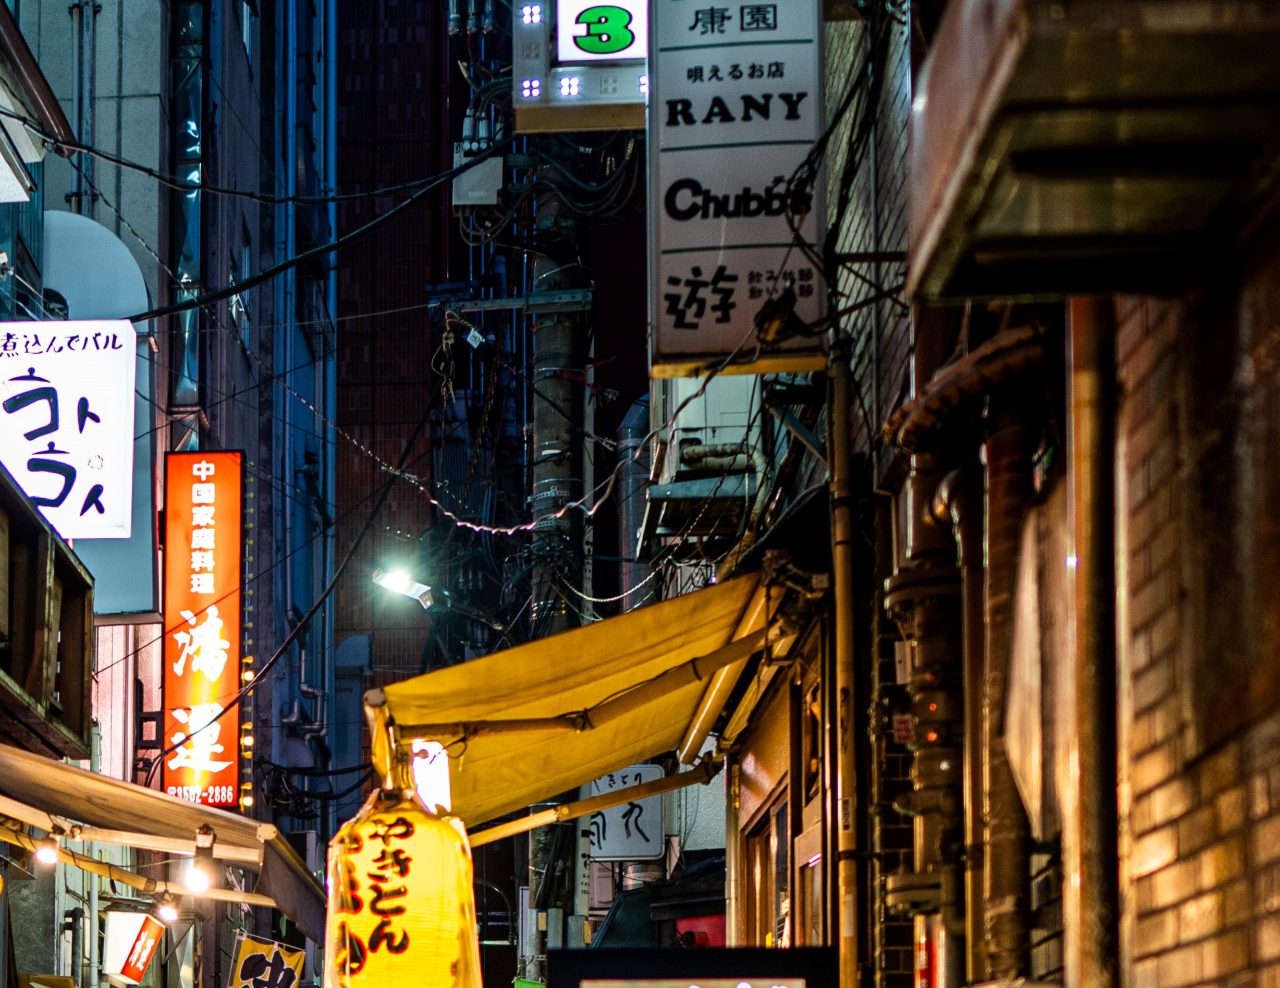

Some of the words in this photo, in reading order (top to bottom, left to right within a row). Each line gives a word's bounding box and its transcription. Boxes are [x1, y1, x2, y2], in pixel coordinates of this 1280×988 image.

[573, 5, 635, 54] 3
[687, 61, 785, 84] 唄えるお店
[665, 92, 808, 127] RANY
[664, 265, 738, 330] 遊
[0, 332, 123, 357] 煮込んでバル
[367, 817, 416, 954] やきとん
